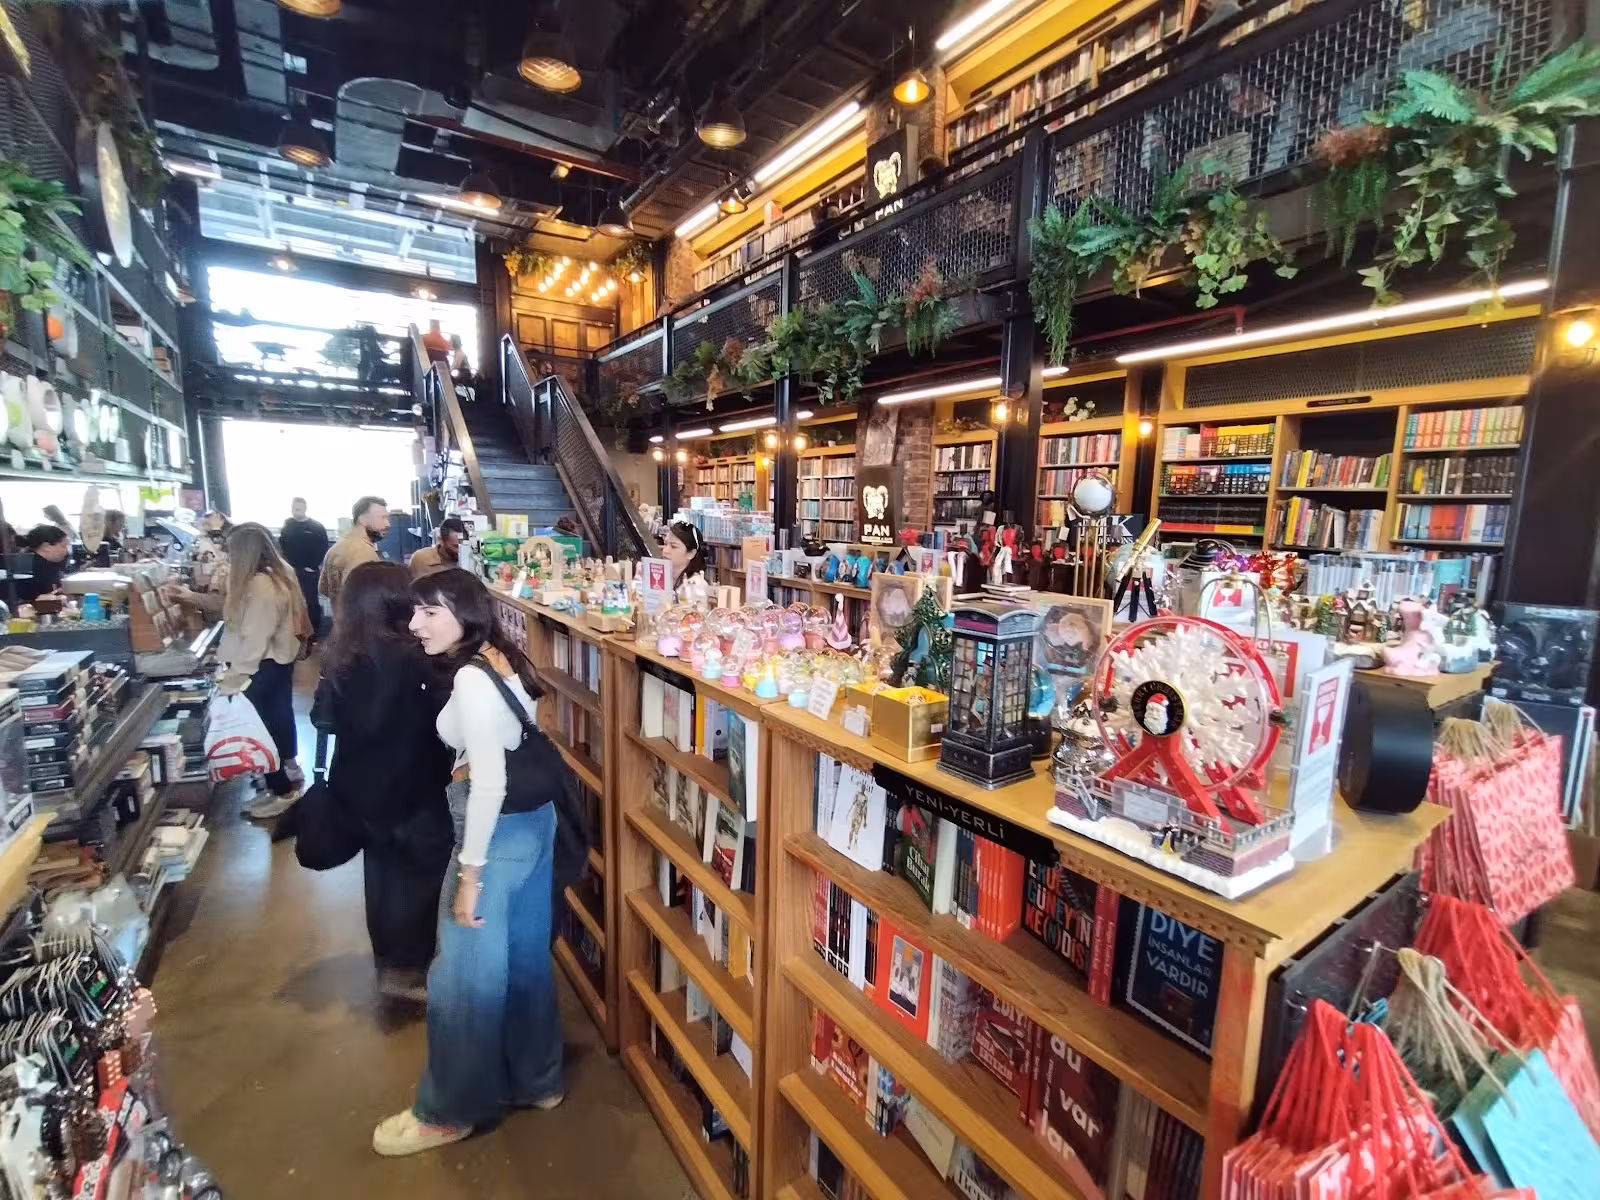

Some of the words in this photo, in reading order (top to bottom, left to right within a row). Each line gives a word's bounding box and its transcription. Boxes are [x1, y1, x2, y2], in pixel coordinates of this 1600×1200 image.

[863, 523, 890, 537] PAN
[905, 784, 1005, 840] YENİ-YERLİ
[1146, 950, 1209, 999] VARDIR
[1041, 1108, 1076, 1161] lar
[1060, 1087, 1100, 1138] var
